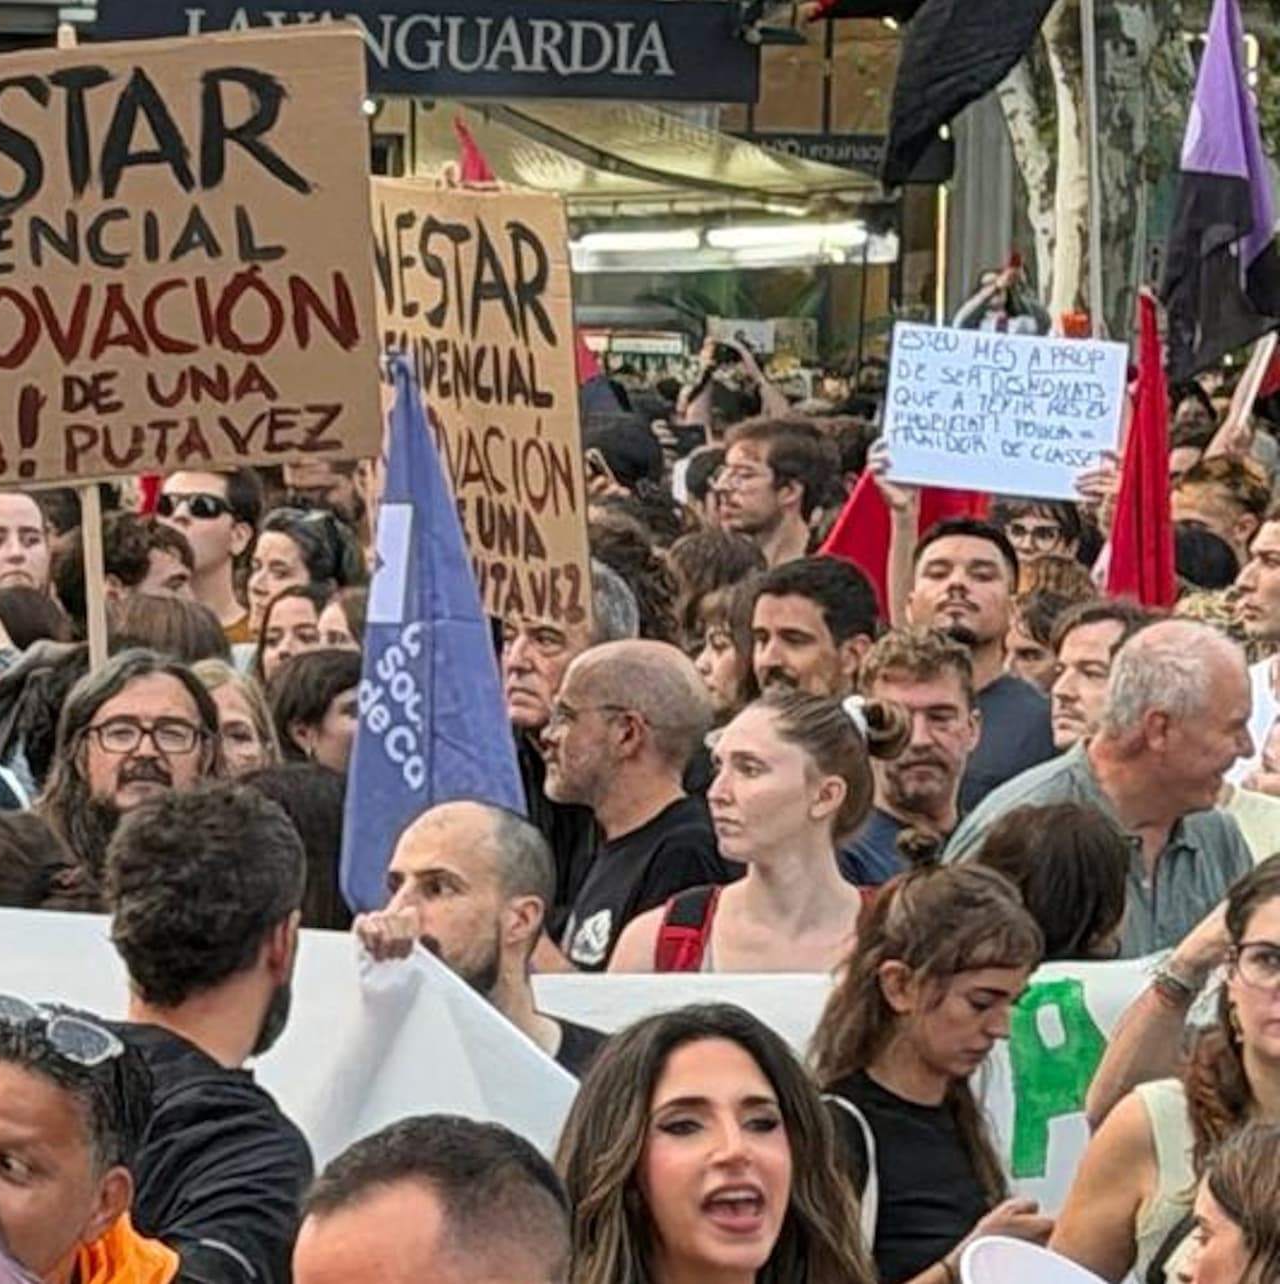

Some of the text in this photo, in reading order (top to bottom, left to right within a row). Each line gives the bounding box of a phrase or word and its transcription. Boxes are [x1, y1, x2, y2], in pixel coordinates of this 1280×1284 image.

[263, 11, 675, 77] NGUARDIA
[61, 361, 279, 414] DE UNA
[894, 386, 940, 407] QUE
[953, 391, 965, 411] A
[897, 359, 927, 382] DE
[65, 402, 344, 473] PUTA VEZ
[476, 496, 547, 563] UNA
[528, 563, 587, 625] VEZ
